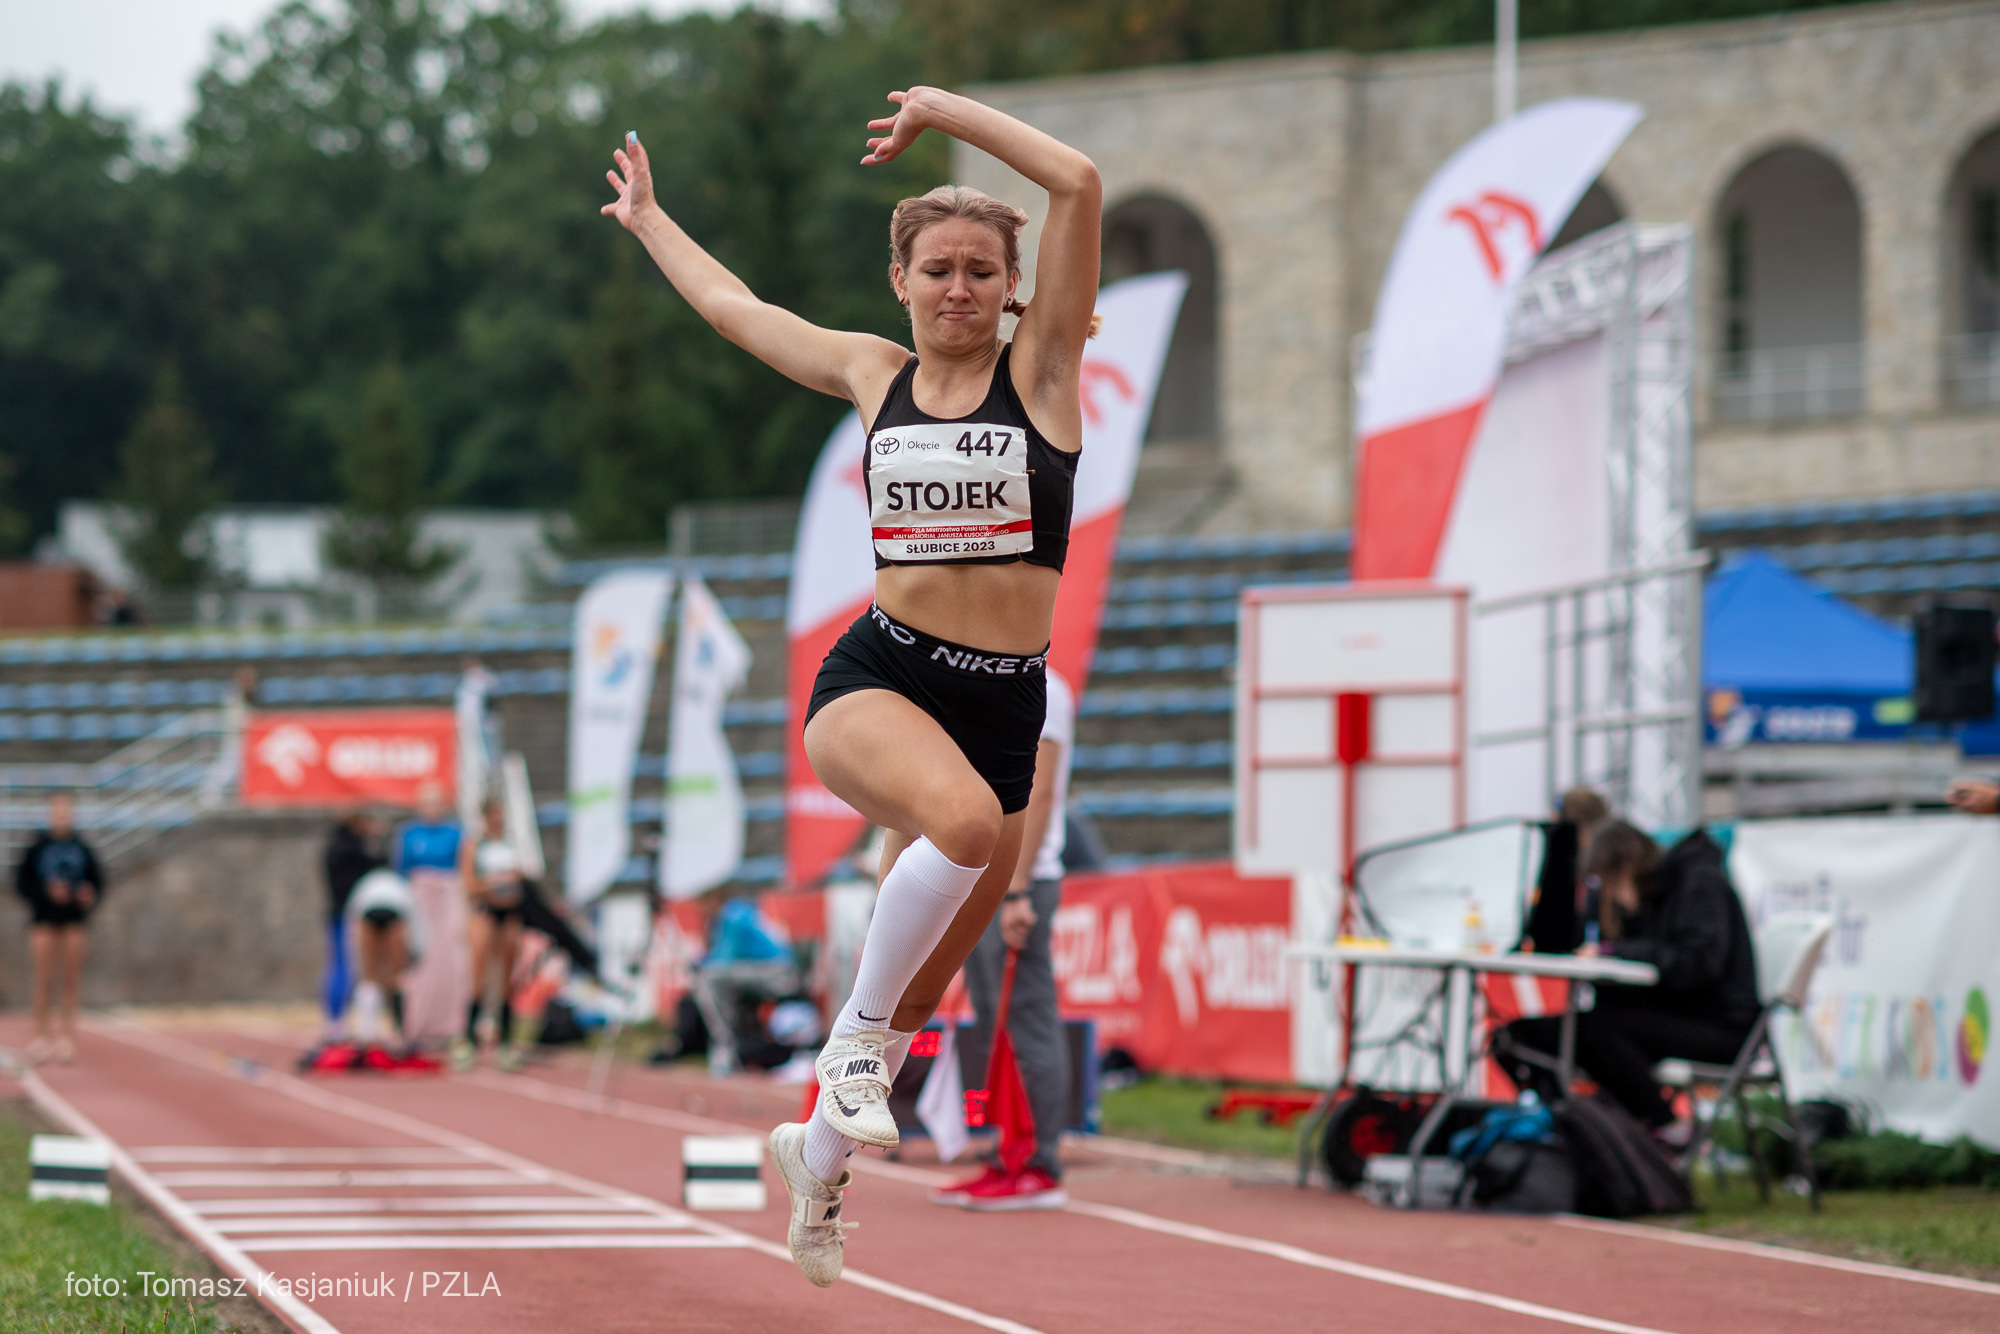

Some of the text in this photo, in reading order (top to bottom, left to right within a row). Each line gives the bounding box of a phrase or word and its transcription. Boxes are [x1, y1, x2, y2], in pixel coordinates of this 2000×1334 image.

[907, 440, 940, 451] Okęcie
[956, 430, 1013, 457] 447
[886, 480, 1009, 511] STOJEK
[926, 525, 960, 533] Mistrzostwa
[906, 540, 996, 554] SŁUBICE 2023
[930, 645, 1020, 675] NIKE
[844, 1059, 881, 1078] NIKE
